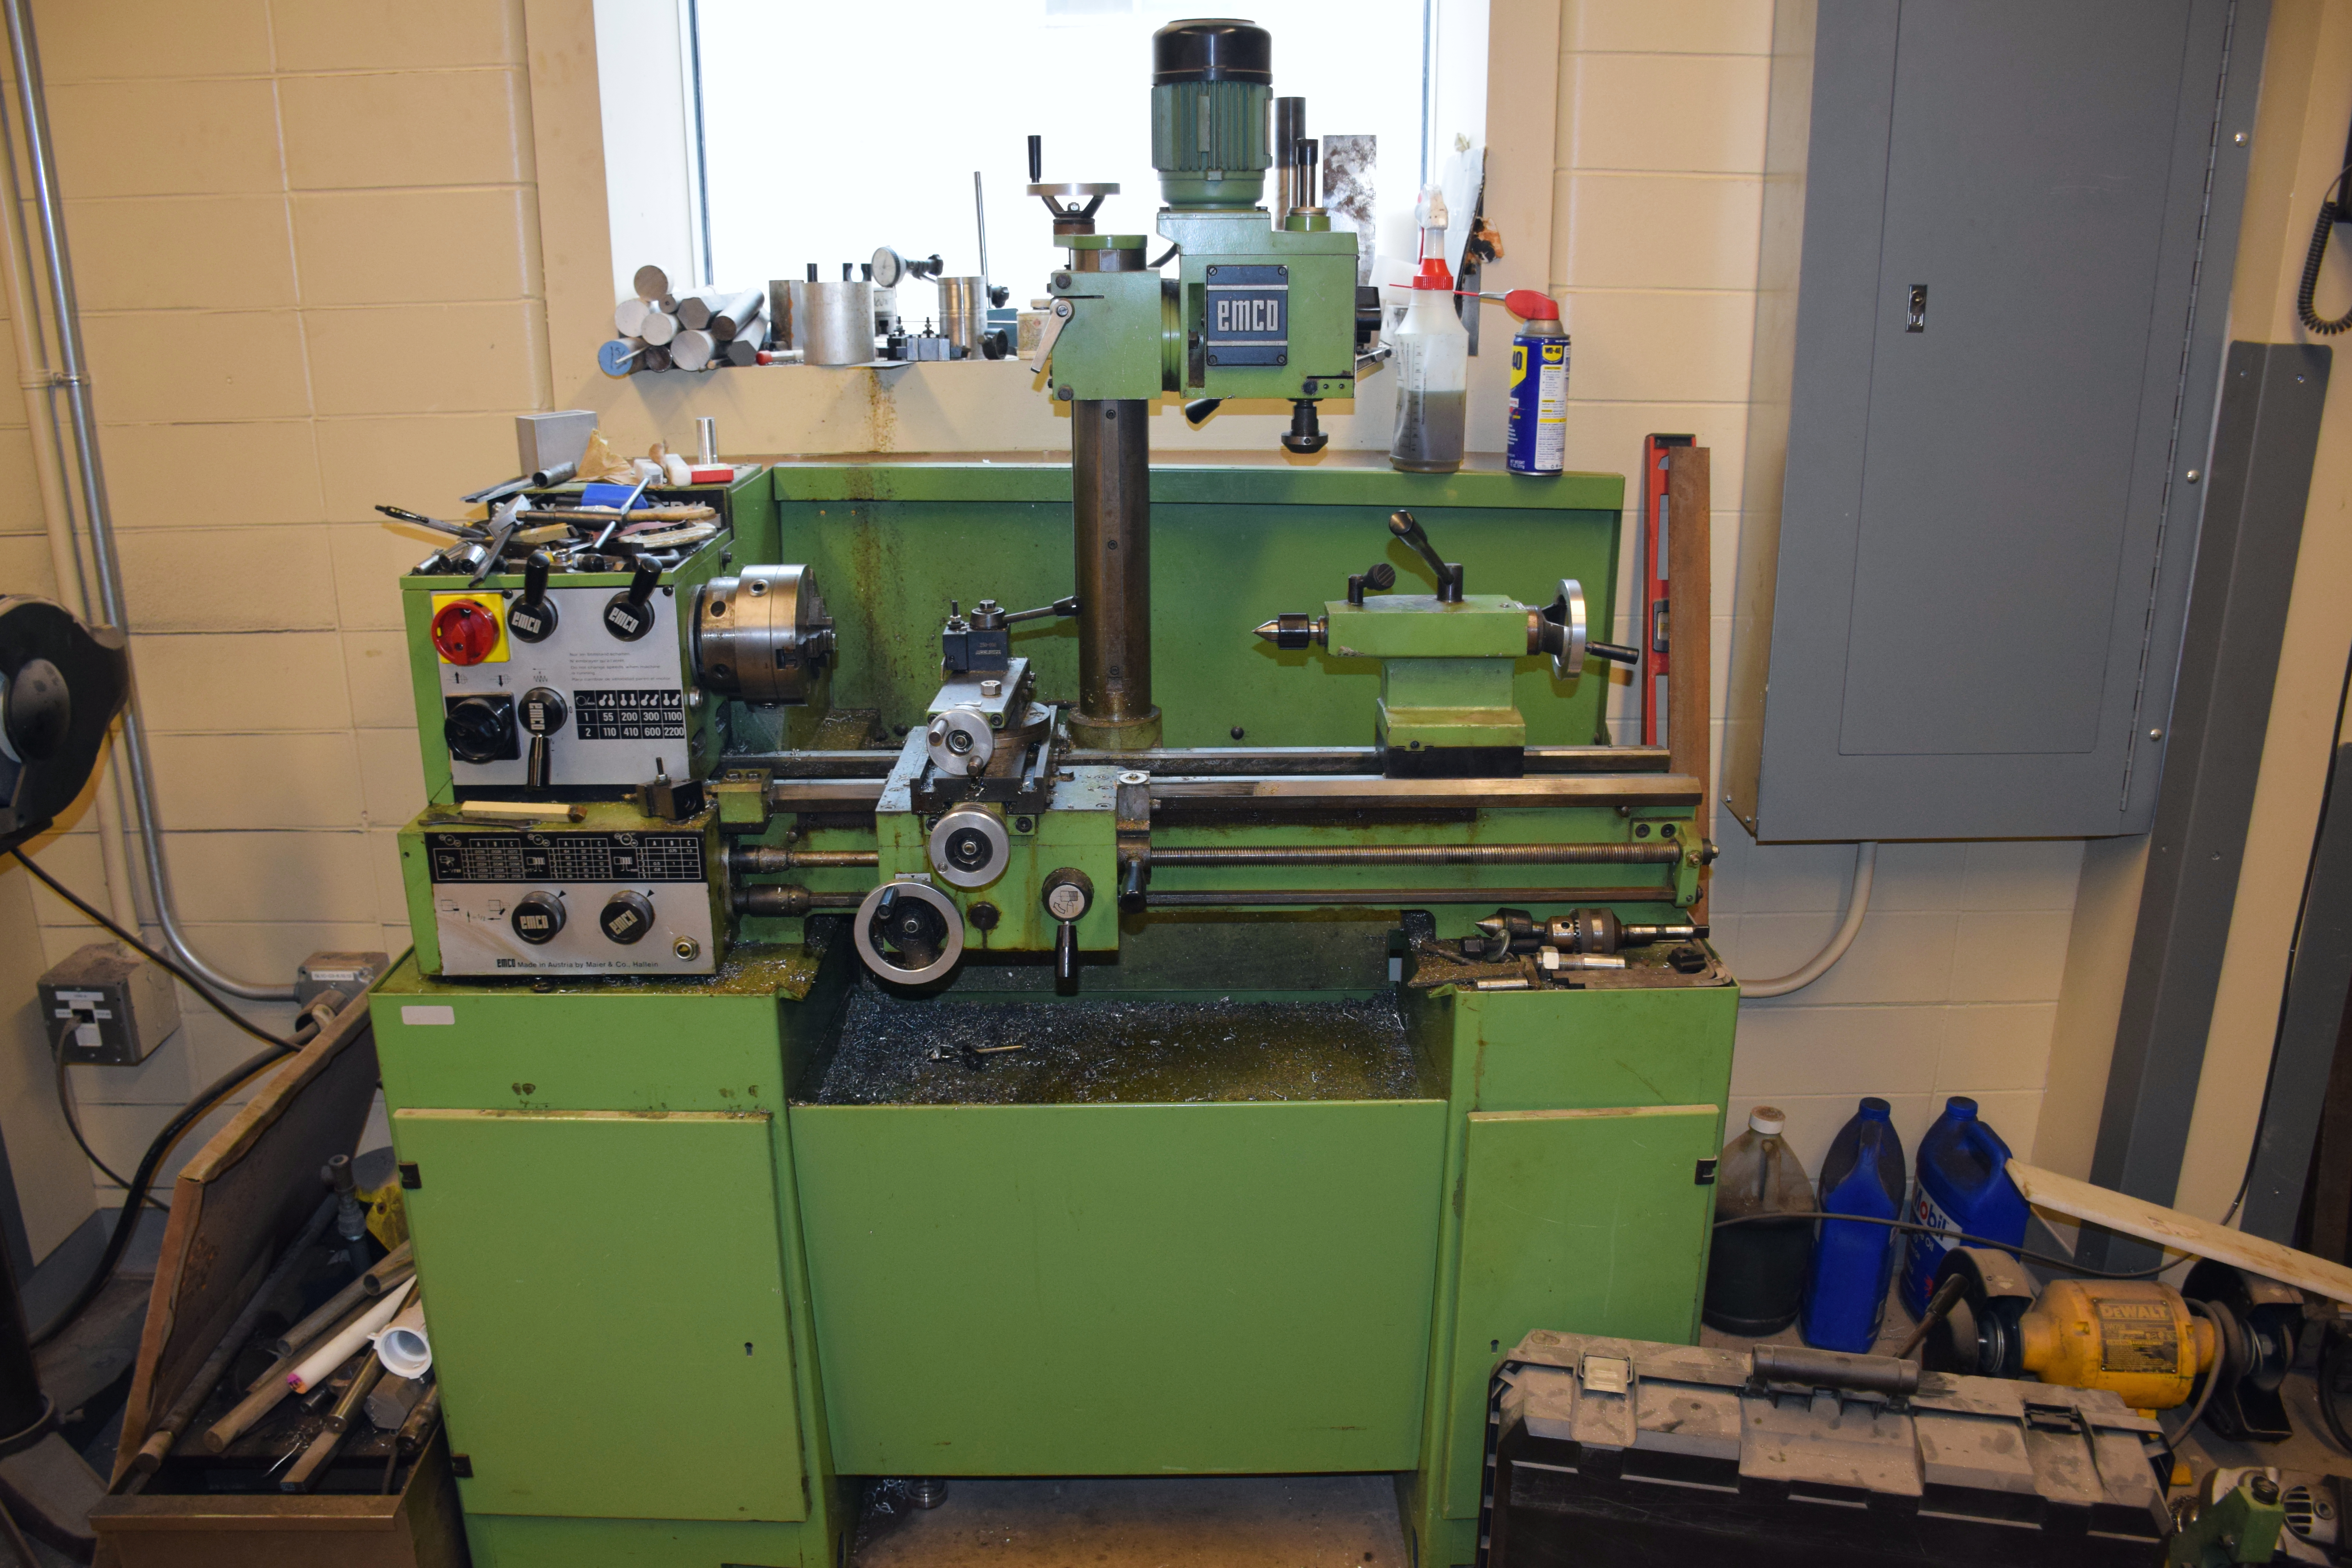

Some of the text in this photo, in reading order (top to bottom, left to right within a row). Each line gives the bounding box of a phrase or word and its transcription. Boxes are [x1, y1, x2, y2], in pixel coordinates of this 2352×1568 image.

[512, 612, 541, 634] emco
[608, 607, 639, 633] emco
[529, 702, 546, 730] emco
[584, 711, 682, 722] 1 55 200 300 1100
[585, 727, 684, 737] 2 110 410 600 2200
[520, 915, 549, 929] emco
[608, 909, 638, 935] emco
[496, 958, 516, 968] emco
